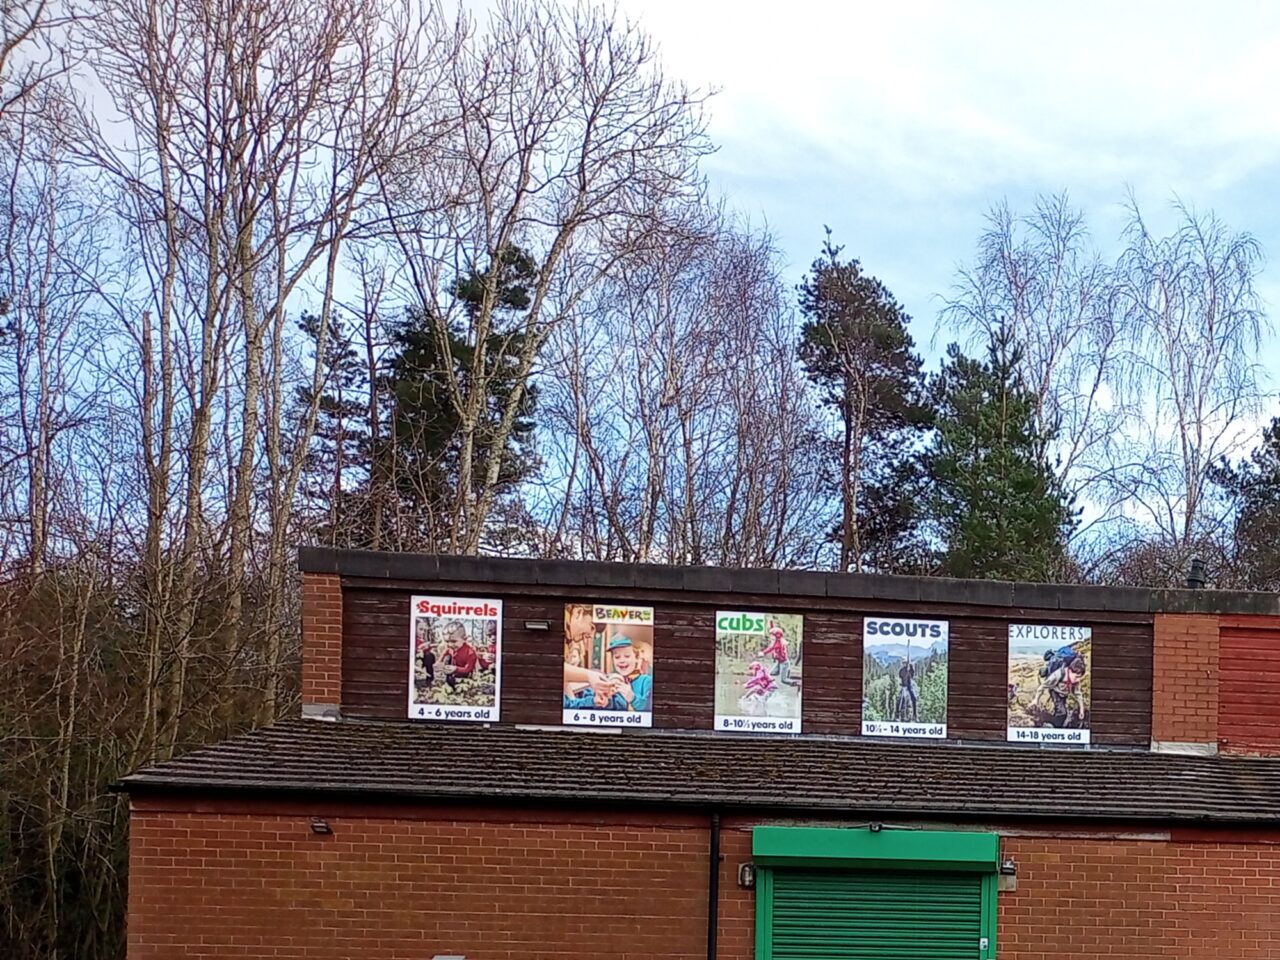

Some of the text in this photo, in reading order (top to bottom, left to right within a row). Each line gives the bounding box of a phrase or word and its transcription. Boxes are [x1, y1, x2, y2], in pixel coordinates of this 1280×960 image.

[416, 600, 498, 617] Squirrels
[718, 613, 764, 632] cubs
[866, 621, 942, 638] SCOUTS
[418, 707, 425, 716] 4
[435, 708, 442, 717] 6
[444, 710, 472, 719] years
[474, 709, 490, 719] old
[573, 713, 580, 721] 6
[589, 713, 596, 722] 8
[598, 714, 624, 724] years
[626, 714, 642, 723] old
[751, 721, 776, 730] years
[778, 721, 793, 730] old
[890, 725, 900, 733] 14
[902, 726, 927, 736] years
[928, 726, 943, 735] old
[1016, 730, 1081, 741] 14-18 years old
